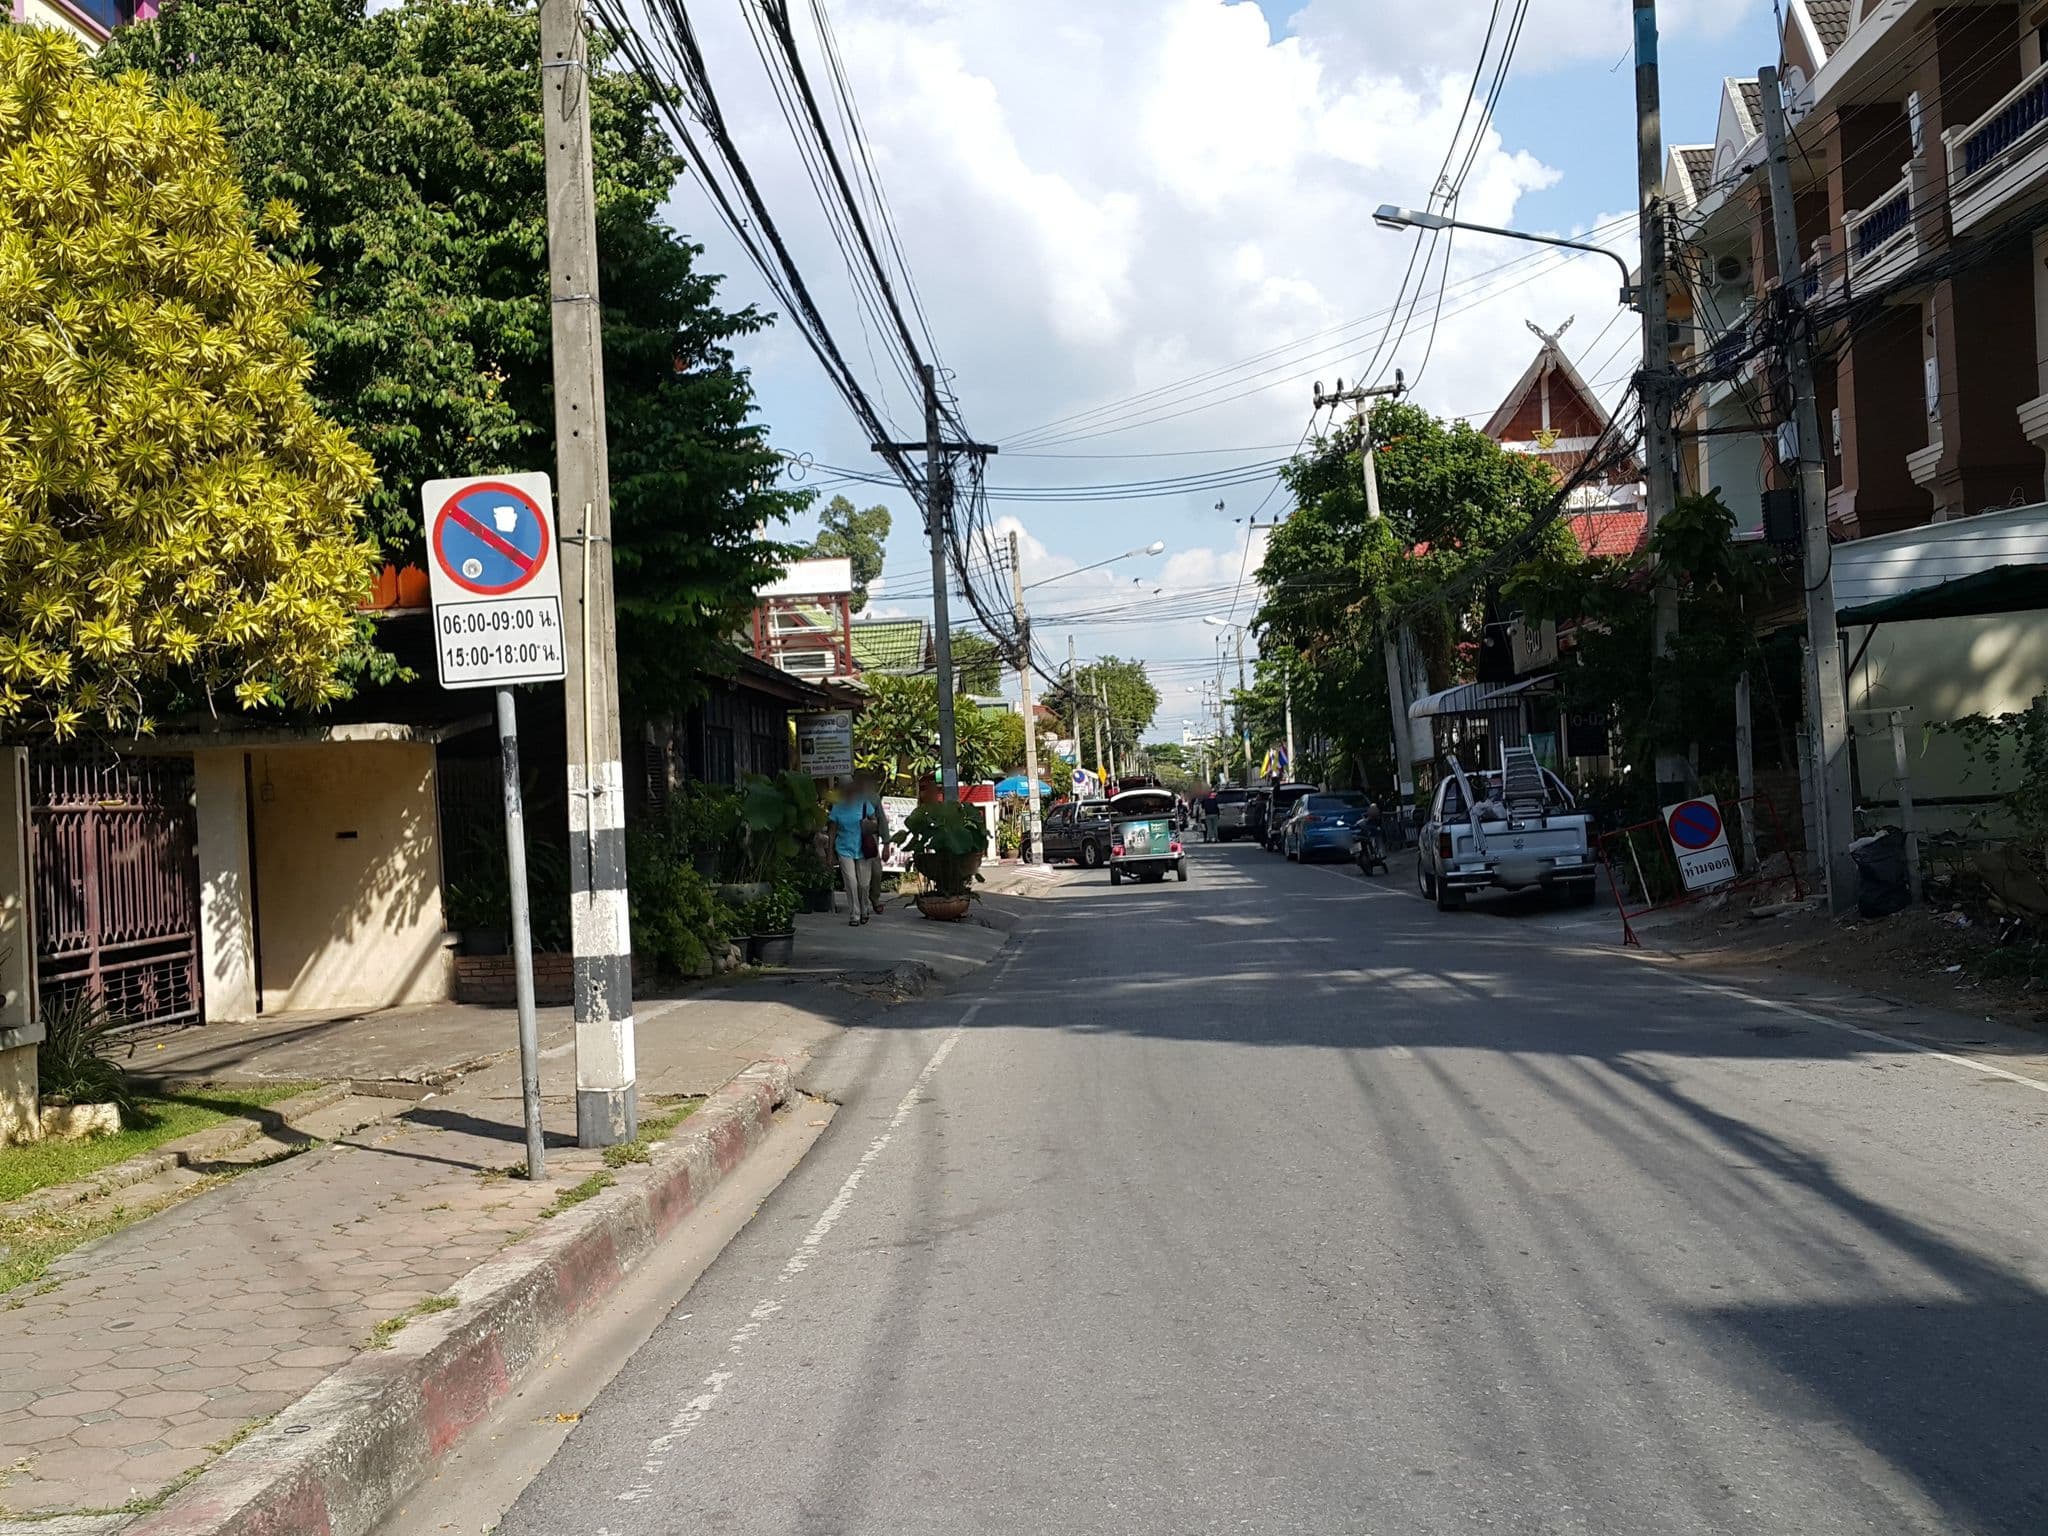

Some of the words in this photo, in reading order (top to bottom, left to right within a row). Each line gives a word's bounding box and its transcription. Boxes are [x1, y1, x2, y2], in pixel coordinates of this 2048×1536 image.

[443, 609, 534, 635] 06:00-09:00
[539, 610, 556, 627] น.
[446, 643, 537, 667] 15:00-18:00
[542, 644, 560, 661] น.
[1684, 857, 1731, 877] ห้ามจอด
